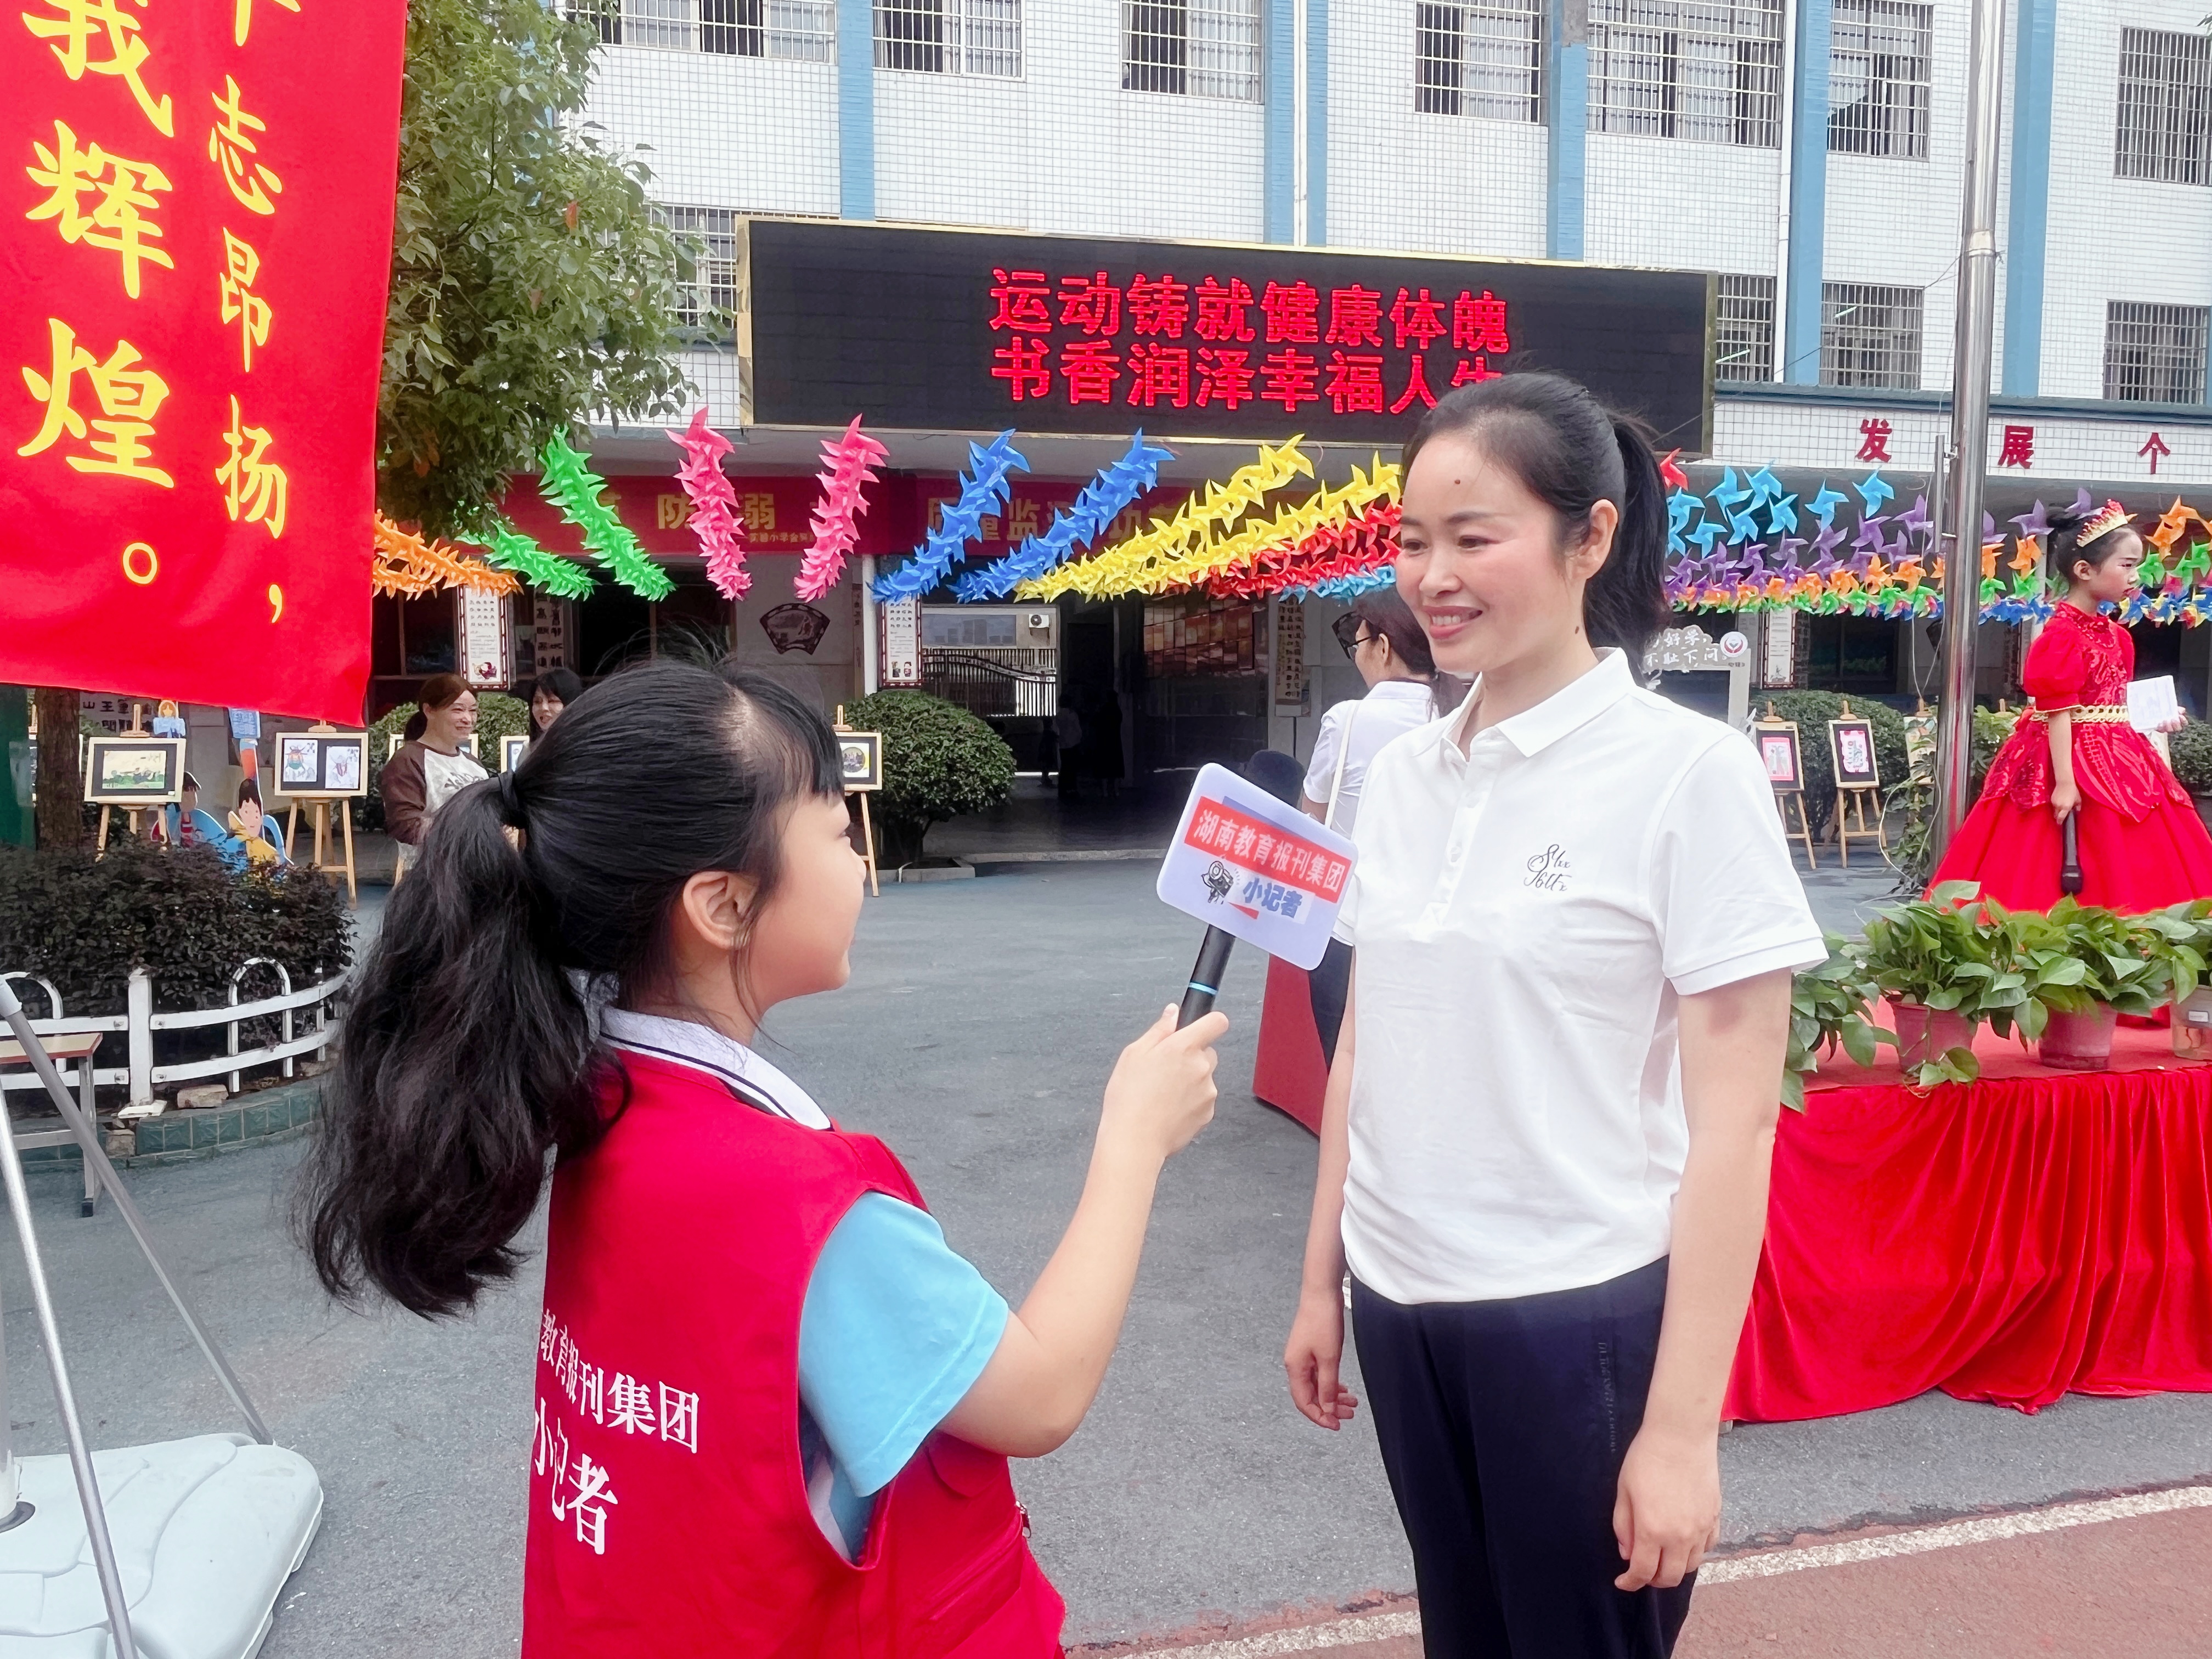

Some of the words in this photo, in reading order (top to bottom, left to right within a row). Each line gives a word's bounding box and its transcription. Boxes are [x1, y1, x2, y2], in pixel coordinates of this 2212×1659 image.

[989, 268, 1509, 353] 运动铸就健康体魄
[1653, 629, 1707, 648] 好学，
[1193, 809, 1346, 893] 湖南教育报刊集团
[1243, 877, 1303, 918] 小记者
